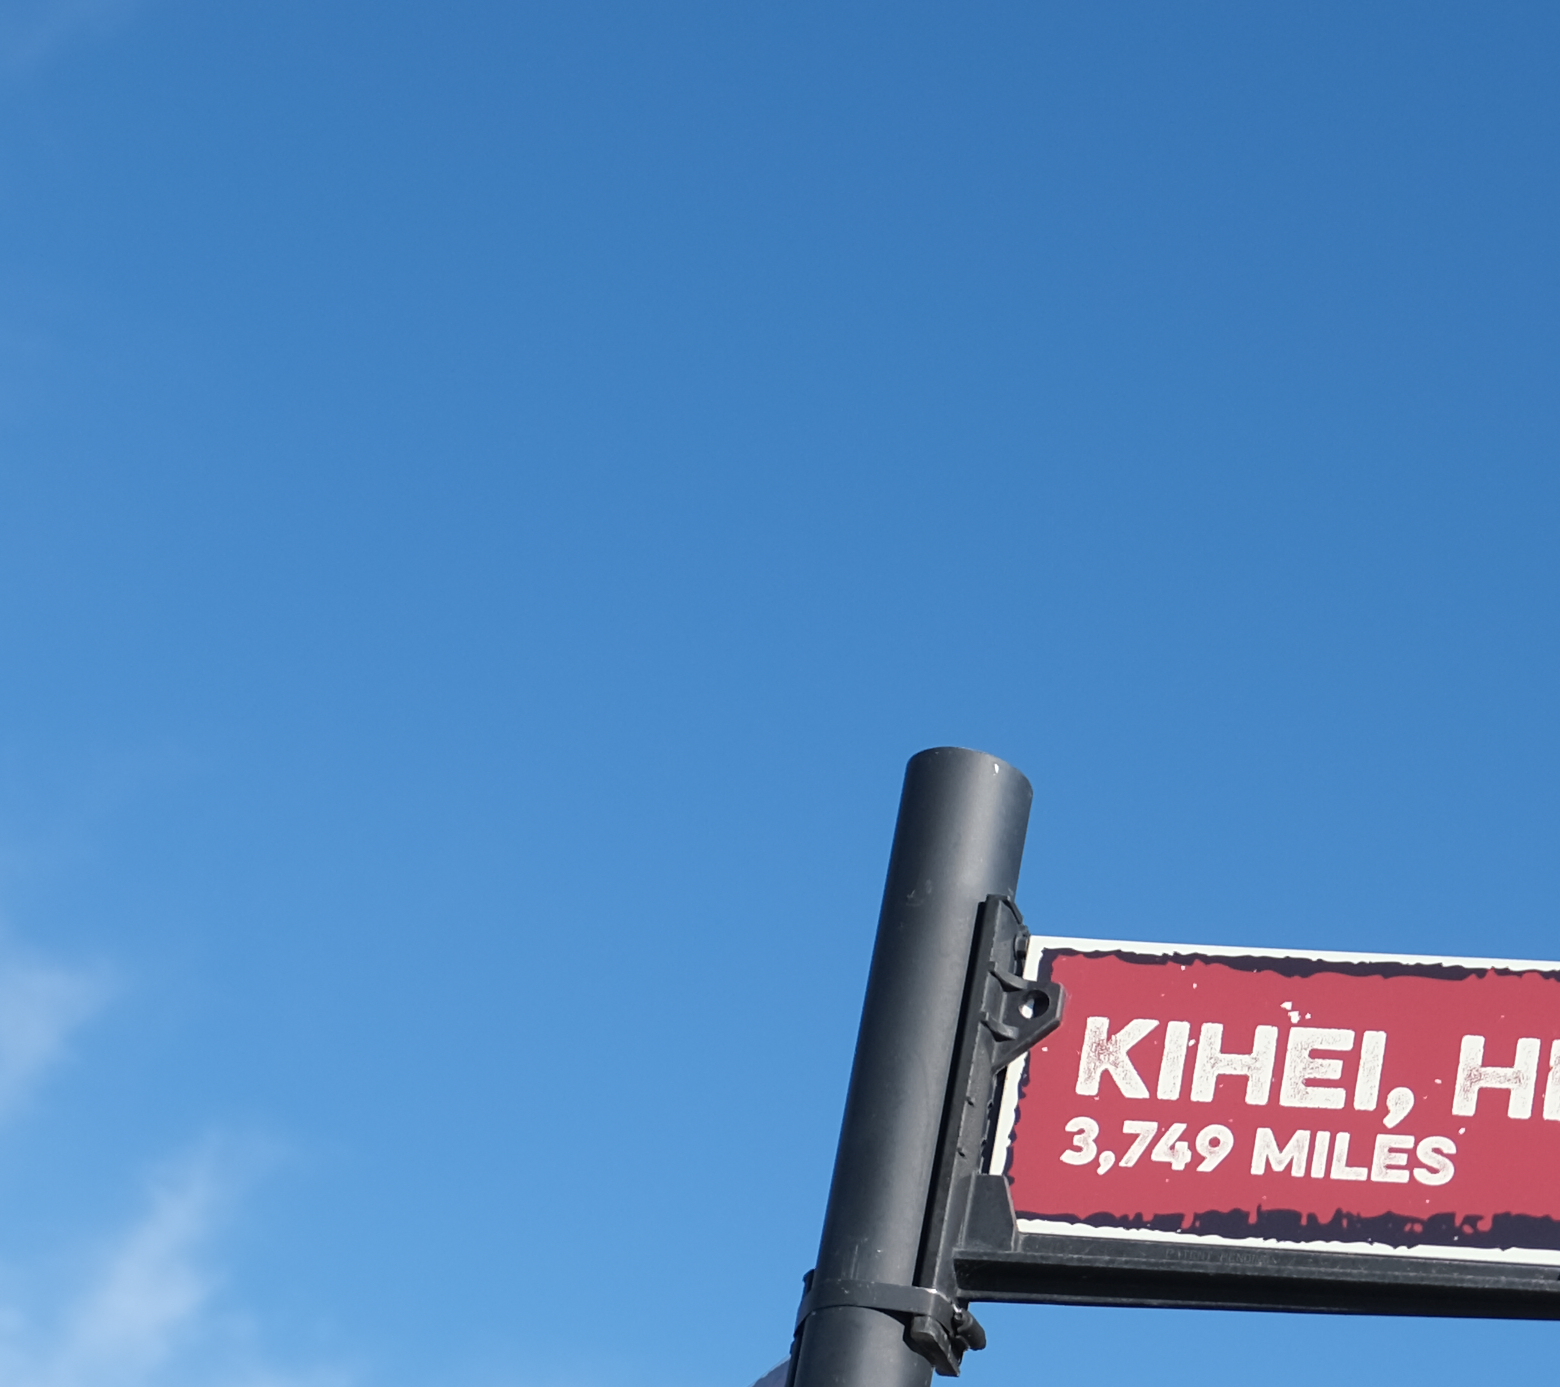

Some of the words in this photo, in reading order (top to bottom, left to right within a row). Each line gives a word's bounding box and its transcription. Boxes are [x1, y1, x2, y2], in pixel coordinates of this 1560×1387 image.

[1075, 1015, 1415, 1128] KIHEI,
[1059, 1115, 1234, 1175] 3,749
[1250, 1127, 1457, 1186] MILES
